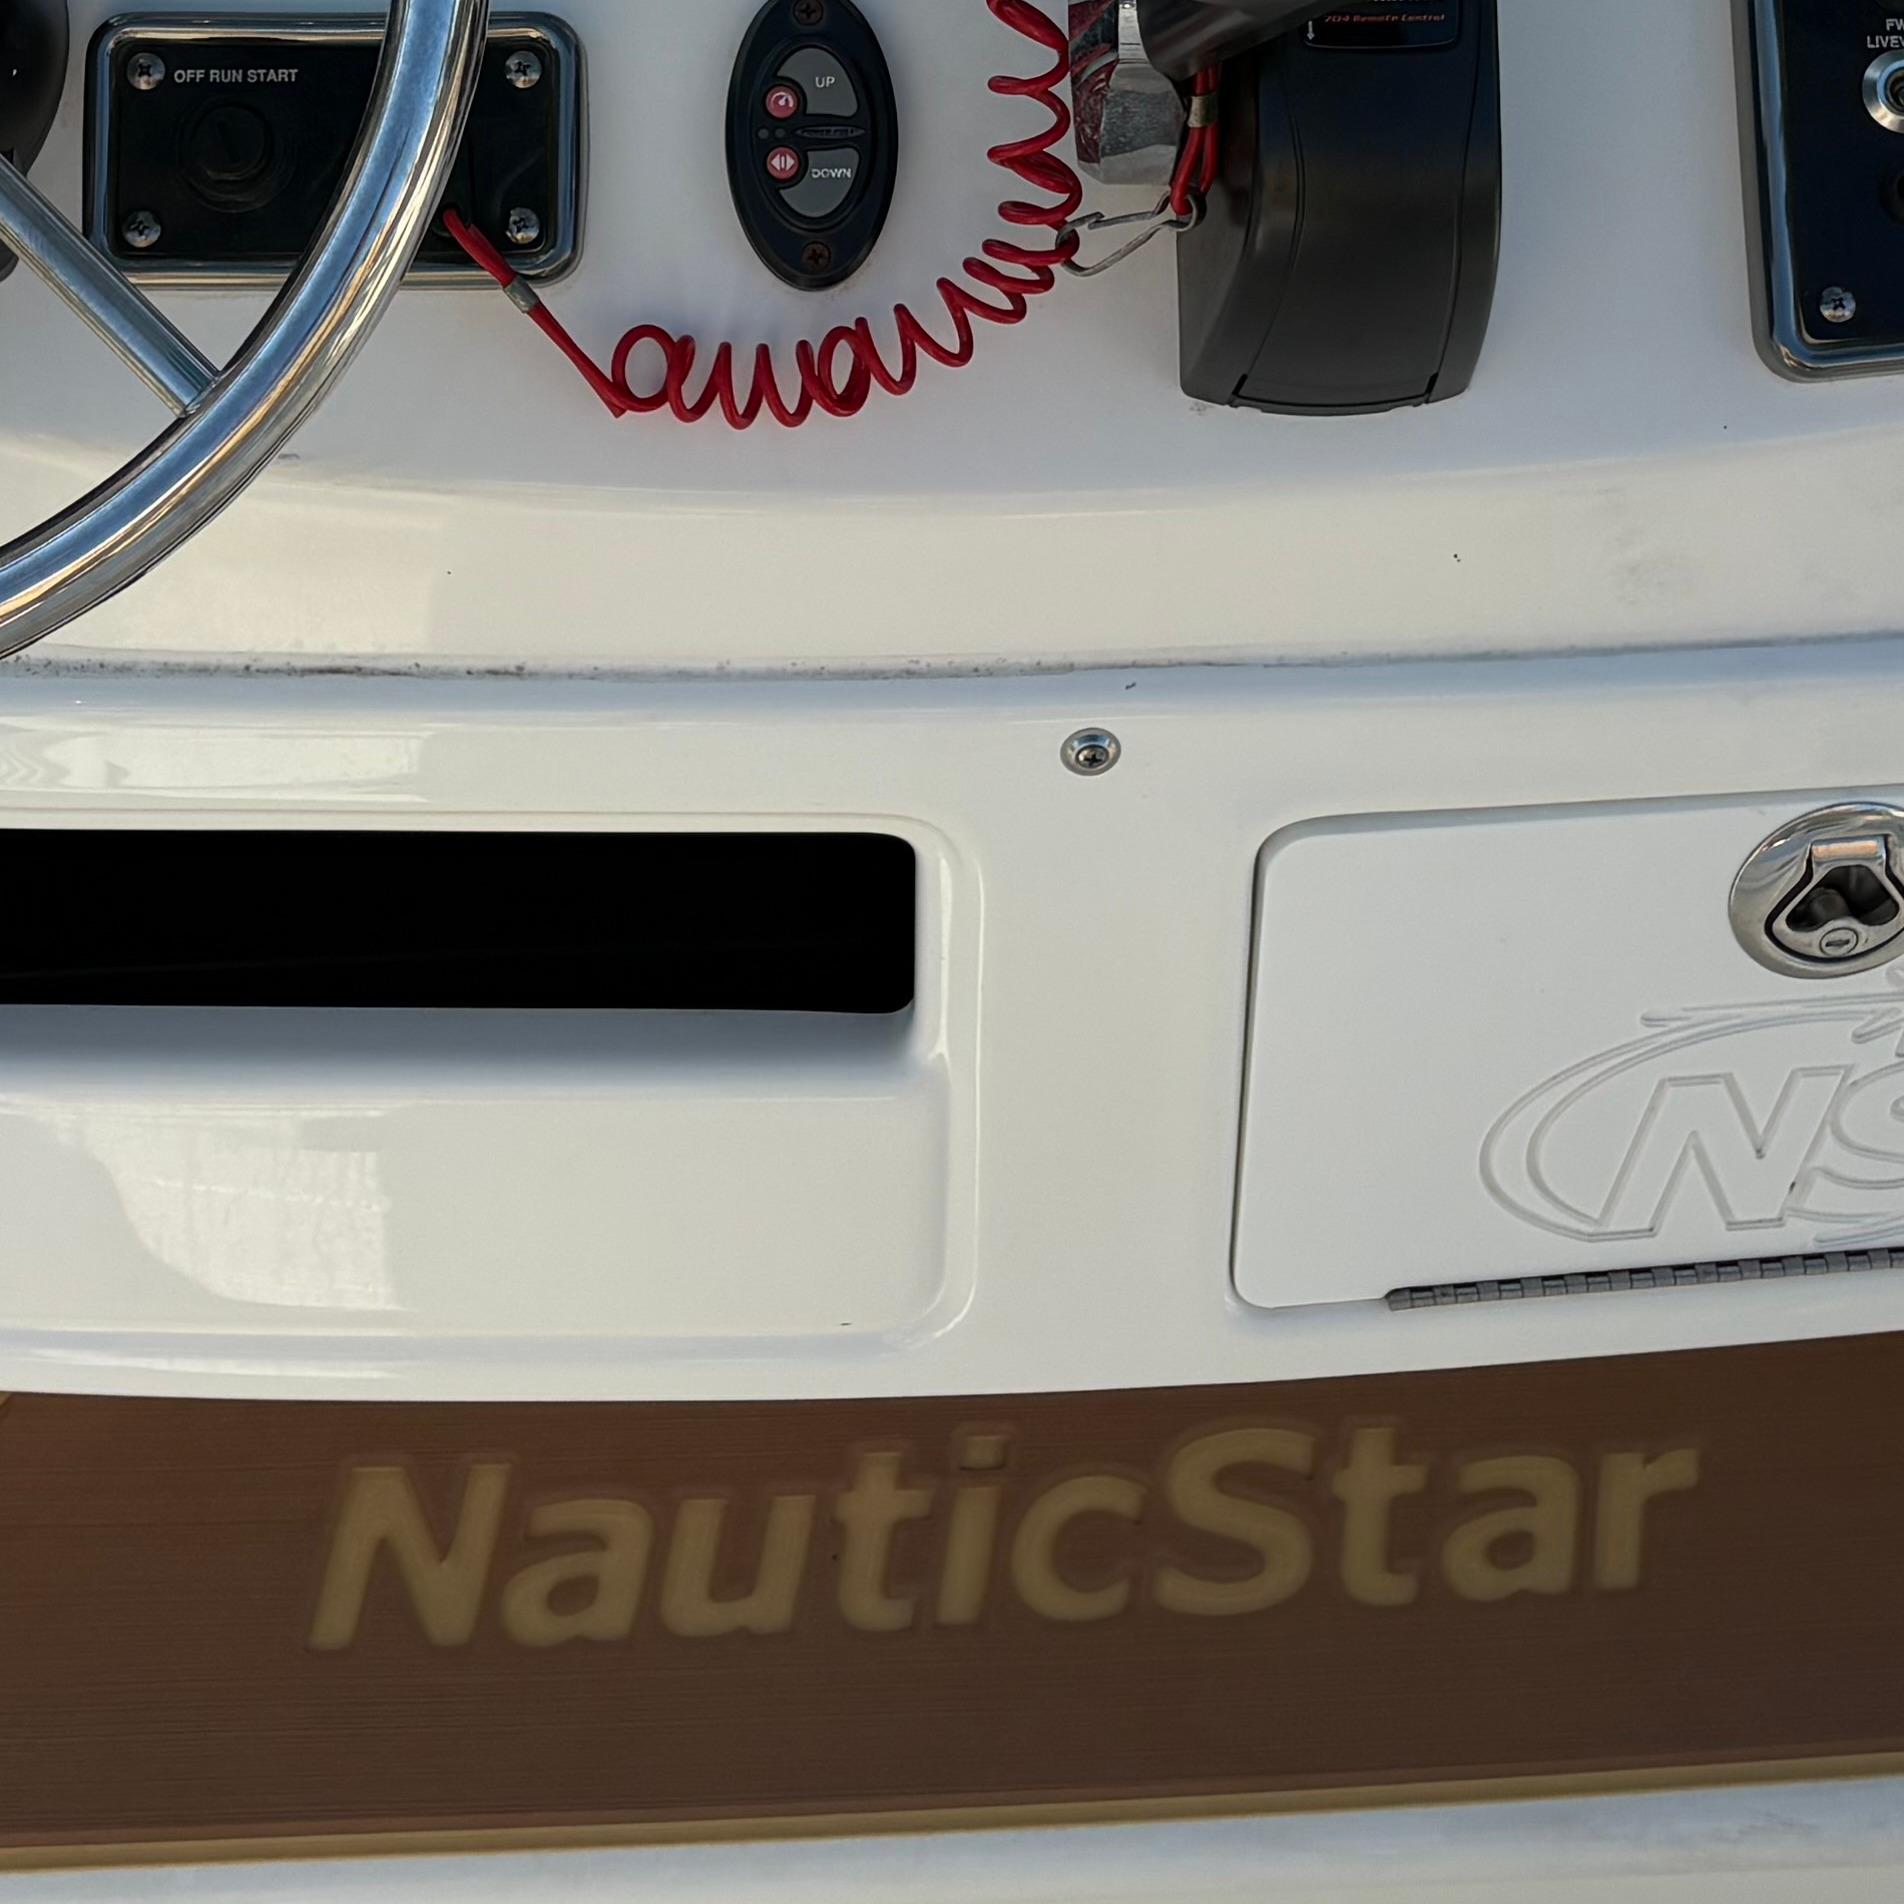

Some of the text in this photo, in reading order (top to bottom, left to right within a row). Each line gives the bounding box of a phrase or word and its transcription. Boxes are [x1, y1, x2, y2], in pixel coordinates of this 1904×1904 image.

[174, 68, 299, 84] OFF RUN START
[816, 76, 836, 88] UP
[812, 168, 852, 178] DOWN
[308, 1424, 1699, 1649] NauticStar
